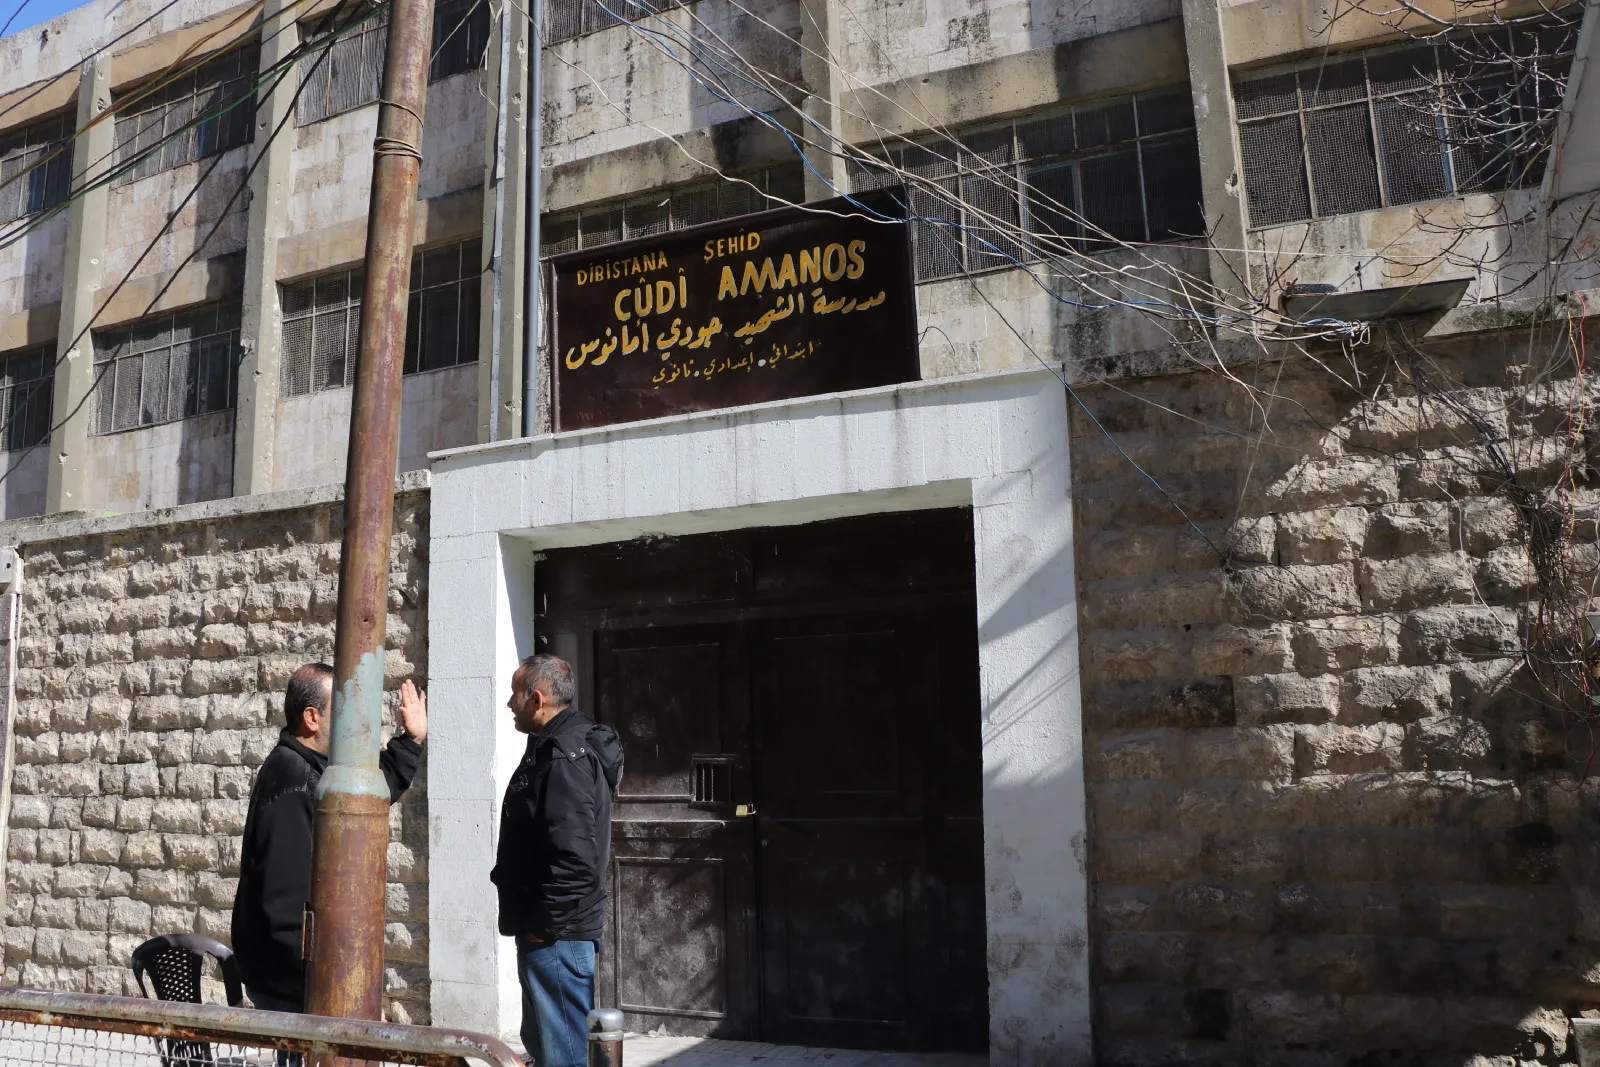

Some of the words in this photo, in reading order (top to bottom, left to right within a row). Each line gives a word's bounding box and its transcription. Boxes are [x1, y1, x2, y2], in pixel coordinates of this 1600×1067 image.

[703, 229, 760, 263] ŞEHÎD
[614, 268, 687, 321] CÛDÎ
[718, 240, 865, 301] AMANOS
[811, 287, 886, 316] مدرسة
[656, 316, 722, 361] جودي
[733, 292, 804, 345] الشهيد
[565, 318, 649, 370] أمانوس
